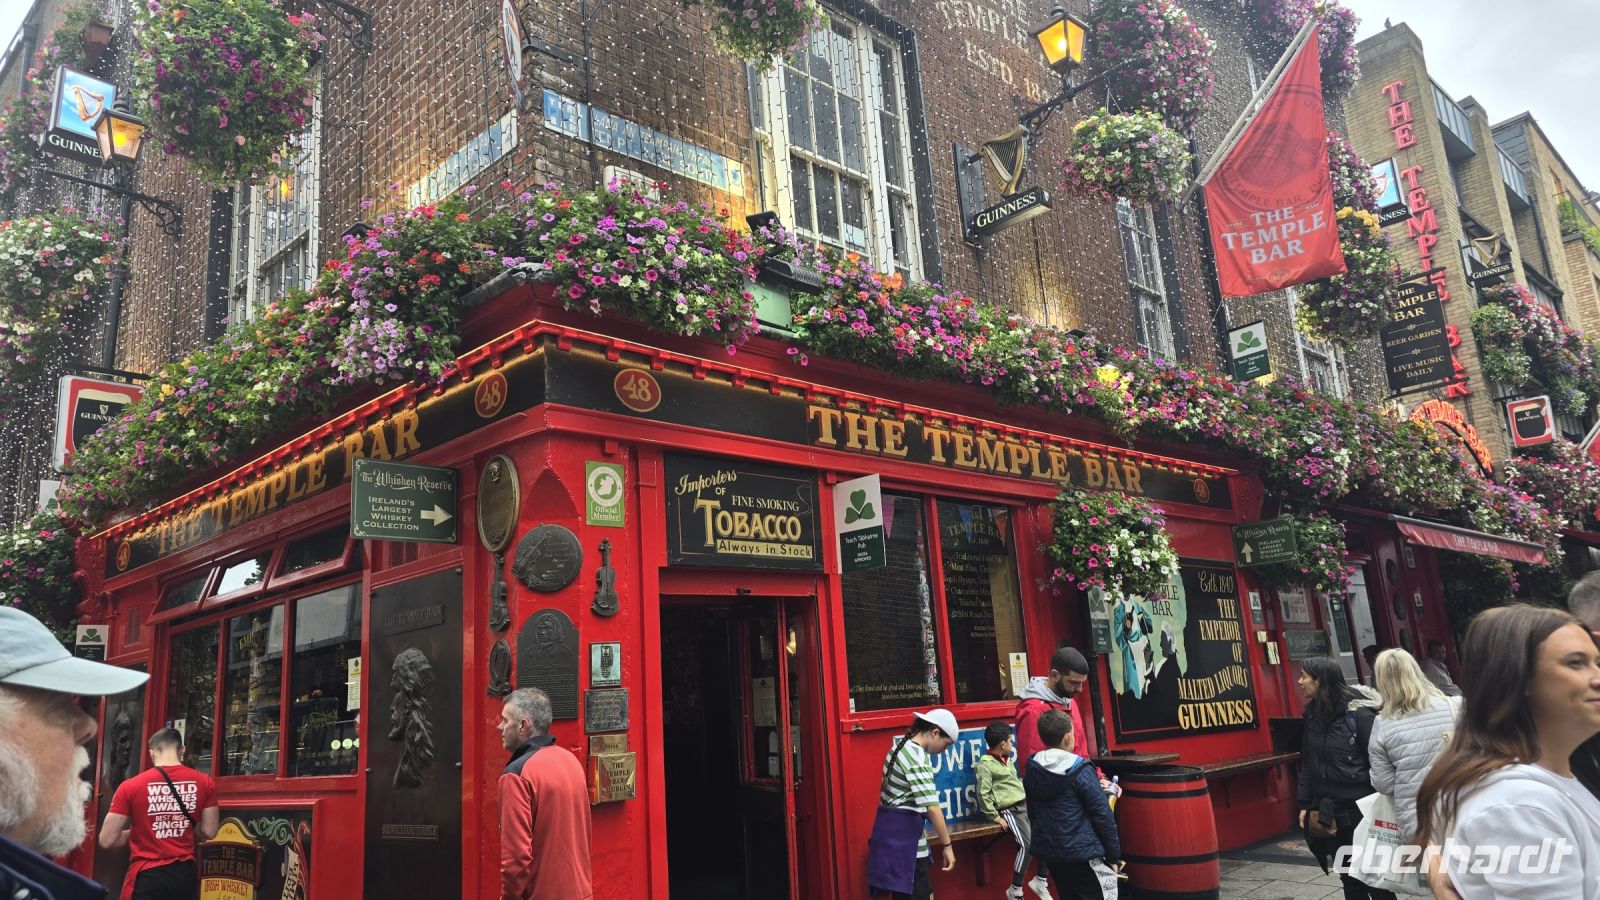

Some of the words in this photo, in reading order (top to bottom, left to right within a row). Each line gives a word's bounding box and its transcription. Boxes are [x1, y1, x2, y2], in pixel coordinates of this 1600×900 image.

[1382, 79, 1418, 150] THE
[48, 133, 101, 159] GUINNE
[976, 192, 1036, 227] GUINNESS
[1252, 206, 1295, 226] THE
[1380, 206, 1407, 223] NNESS
[1221, 210, 1327, 250] TEMPLE
[1250, 239, 1305, 265] BAR
[1472, 264, 1510, 280] GUINNESS
[1399, 291, 1438, 309] MPLE
[1394, 307, 1426, 322] BAR
[1386, 336, 1407, 348] BEER
[1407, 327, 1442, 342] GARDEN
[1393, 362, 1414, 373] LIVE
[1415, 355, 1445, 368] MUSIC
[1406, 366, 1434, 378] DAILY
[479, 379, 501, 411] 48
[622, 374, 652, 401] 48
[81, 411, 119, 422] GUINNES
[808, 404, 909, 457] THE
[922, 426, 1072, 483] TEMPLE
[1082, 455, 1144, 494] BAR
[210, 455, 327, 532] TEMPLE
[344, 408, 421, 479] BAR
[360, 471, 373, 483] The
[373, 468, 416, 490] Whiskey
[417, 474, 452, 494] Reserve
[674, 469, 737, 498] Importers
[715, 486, 726, 496] OF
[371, 504, 412, 514] LARGEST
[595, 505, 618, 514] Official
[731, 494, 755, 508] FINE
[756, 497, 800, 512] SMOKING
[362, 520, 419, 531] COLLECTION
[370, 512, 412, 522] WHISKEY
[593, 512, 621, 521] Member
[693, 498, 802, 547] TOBACCO
[718, 539, 761, 555] Always
[766, 543, 777, 555] in
[780, 542, 811, 557] Stock
[1219, 575, 1233, 594] 1840
[1152, 601, 1174, 617] BAR
[1217, 598, 1237, 619] THE
[1199, 619, 1241, 641] EMPEROR
[1231, 642, 1243, 663] OF
[1177, 676, 1216, 701] MALTED
[1214, 664, 1249, 695] LIQUORS
[1177, 699, 1254, 730] GUINNESS
[606, 769, 631, 779] TEMPLE
[147, 783, 198, 796] WORLD
[606, 783, 631, 794] DUBLIN
[152, 819, 190, 831] SINGLE
[155, 828, 186, 839] MALT
[222, 846, 235, 860] THE
[203, 858, 235, 875] TEMPLE
[237, 861, 254, 879] BAR
[205, 879, 219, 893] IRISH
[221, 879, 249, 897] WHISKEY
